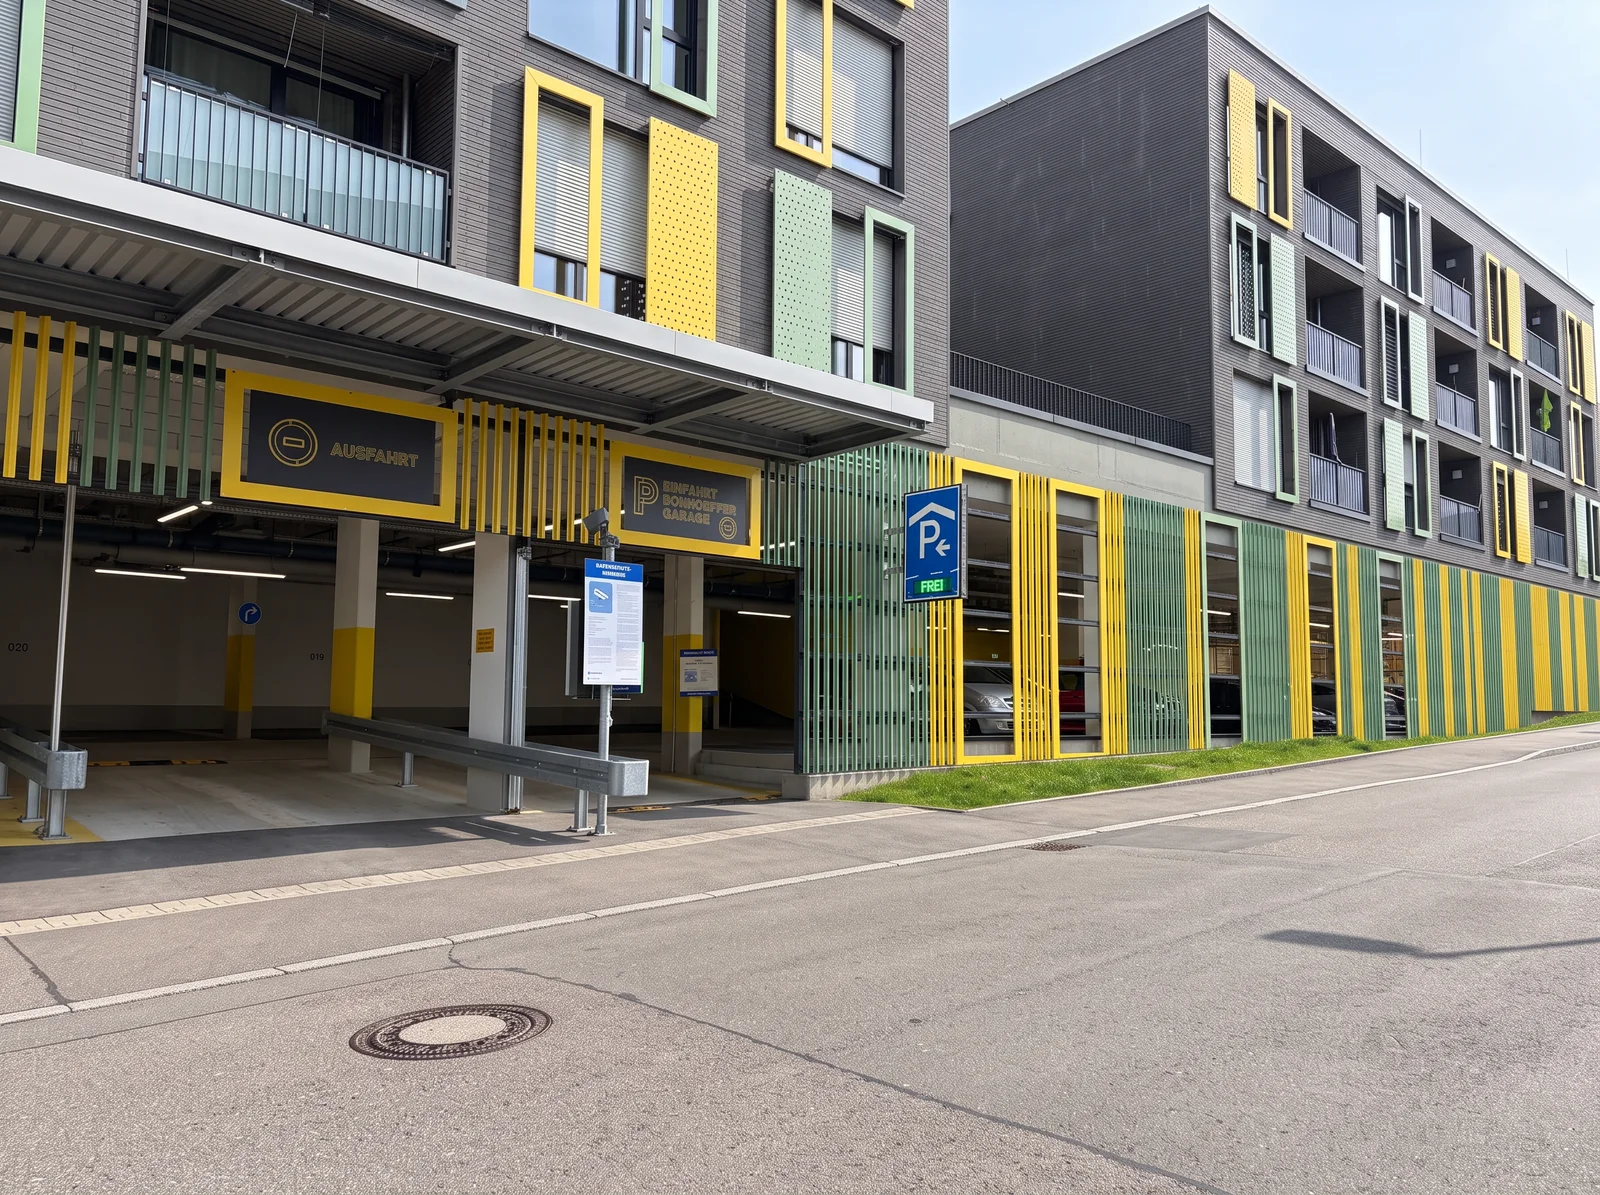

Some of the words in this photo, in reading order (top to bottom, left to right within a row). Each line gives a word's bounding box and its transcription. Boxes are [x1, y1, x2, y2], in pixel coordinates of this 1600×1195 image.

[330, 442, 418, 467] AUSFAHRT
[633, 475, 659, 515] P
[662, 480, 718, 499] EINFAHRT
[662, 493, 737, 516] BONHOEFFER
[662, 507, 711, 525] GARAGE
[919, 519, 941, 559] P
[920, 579, 944, 593] FREI
[7, 642, 29, 652] 020
[309, 652, 325, 661] 019
